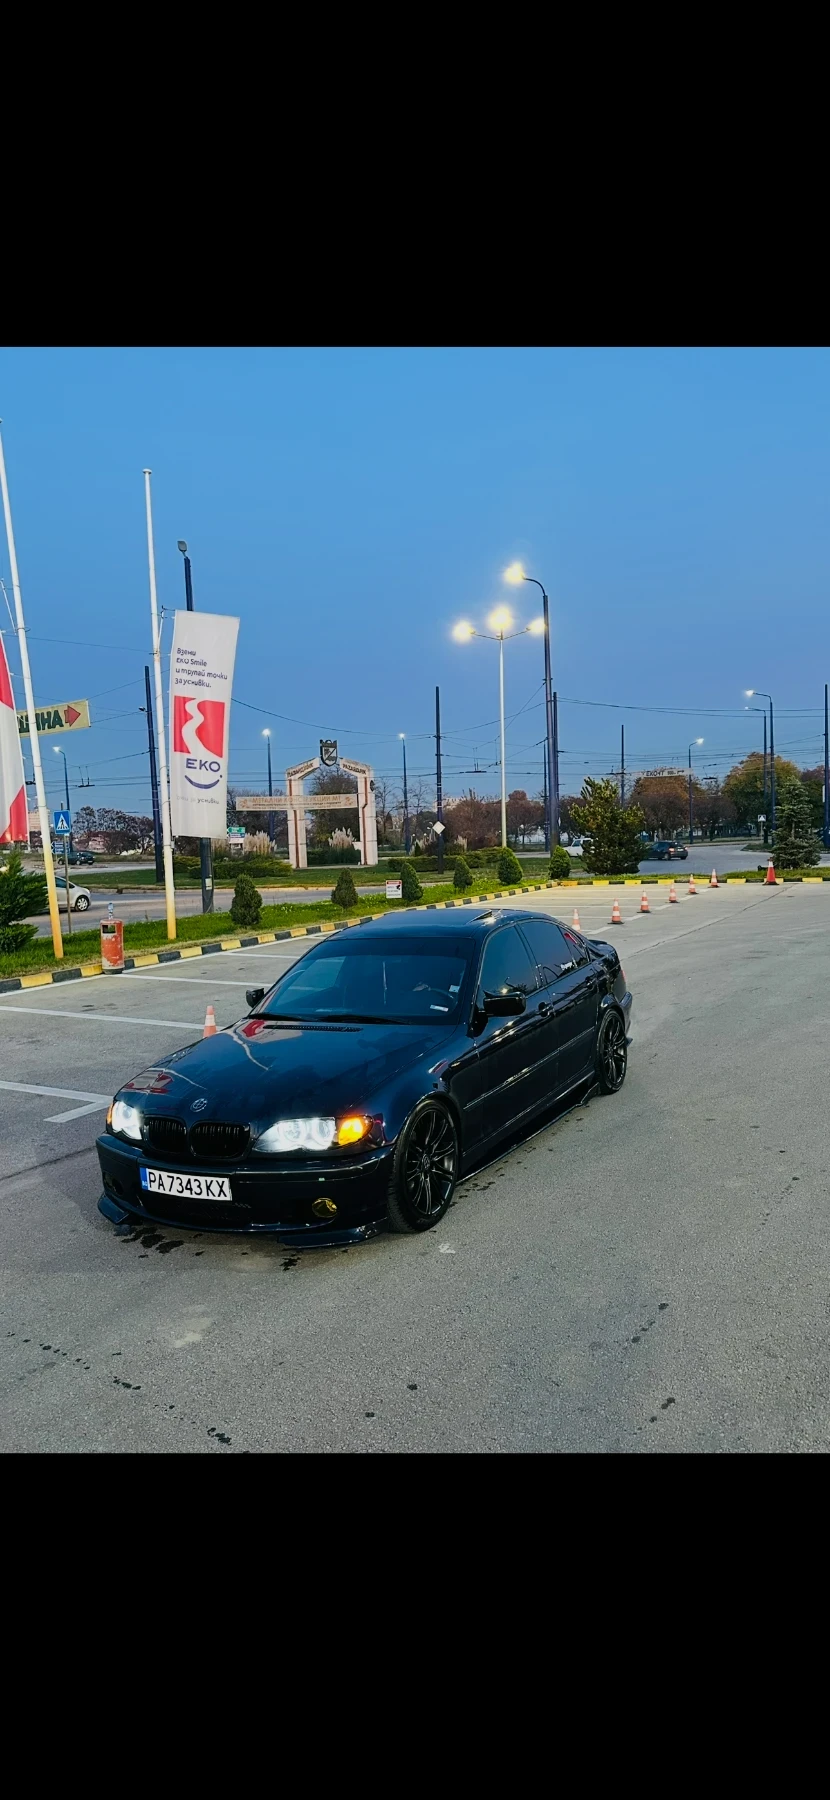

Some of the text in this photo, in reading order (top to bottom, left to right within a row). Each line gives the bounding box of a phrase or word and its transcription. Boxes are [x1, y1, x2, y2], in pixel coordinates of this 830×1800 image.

[190, 658, 208, 667] Smile
[181, 668, 206, 677] трупай
[206, 671, 228, 680] точки
[186, 758, 220, 772] EKO
